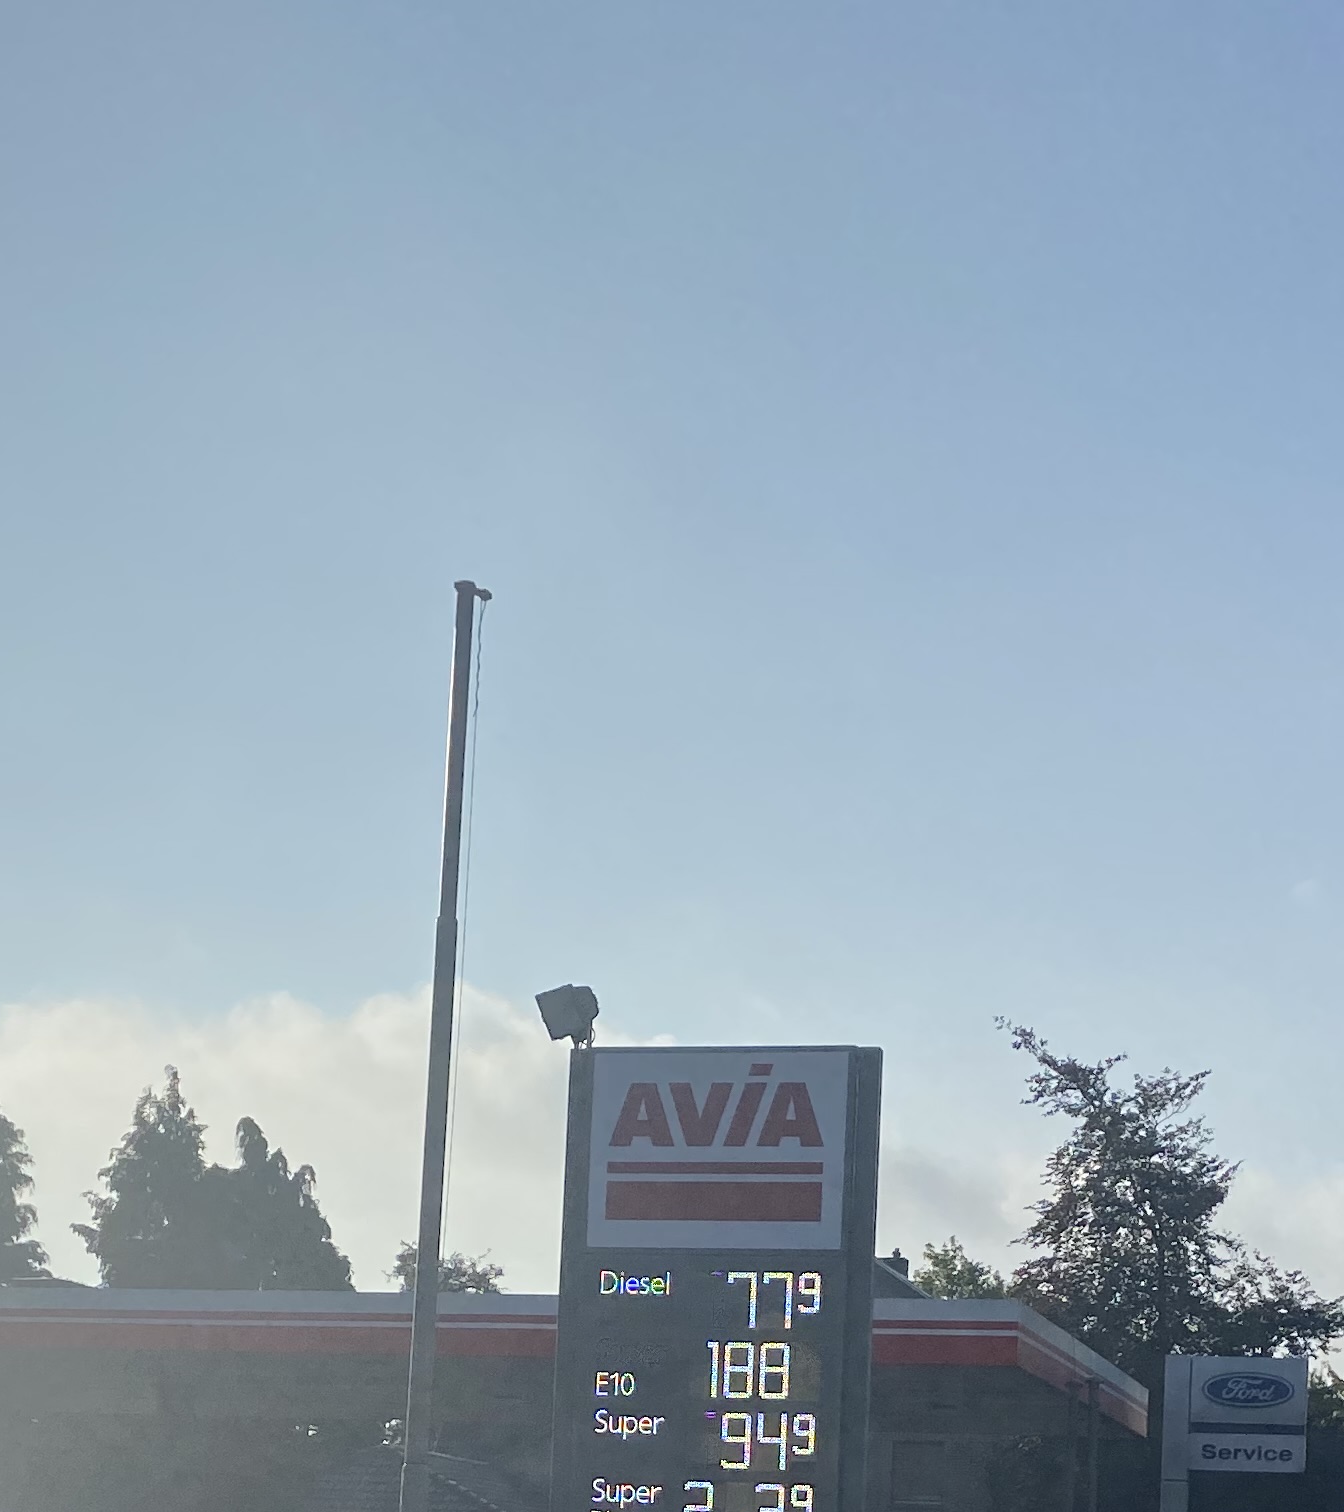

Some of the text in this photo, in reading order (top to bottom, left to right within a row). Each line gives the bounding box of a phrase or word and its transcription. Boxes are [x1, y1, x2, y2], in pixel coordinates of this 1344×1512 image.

[599, 1270, 671, 1295] Diesel
[711, 1271, 822, 1329] 779
[595, 1371, 635, 1396] E10
[1222, 1378, 1276, 1400] Ford
[594, 1409, 665, 1440] Super
[706, 1412, 816, 1470] 949
[1201, 1444, 1293, 1461] Service
[592, 1478, 662, 1508] Super
